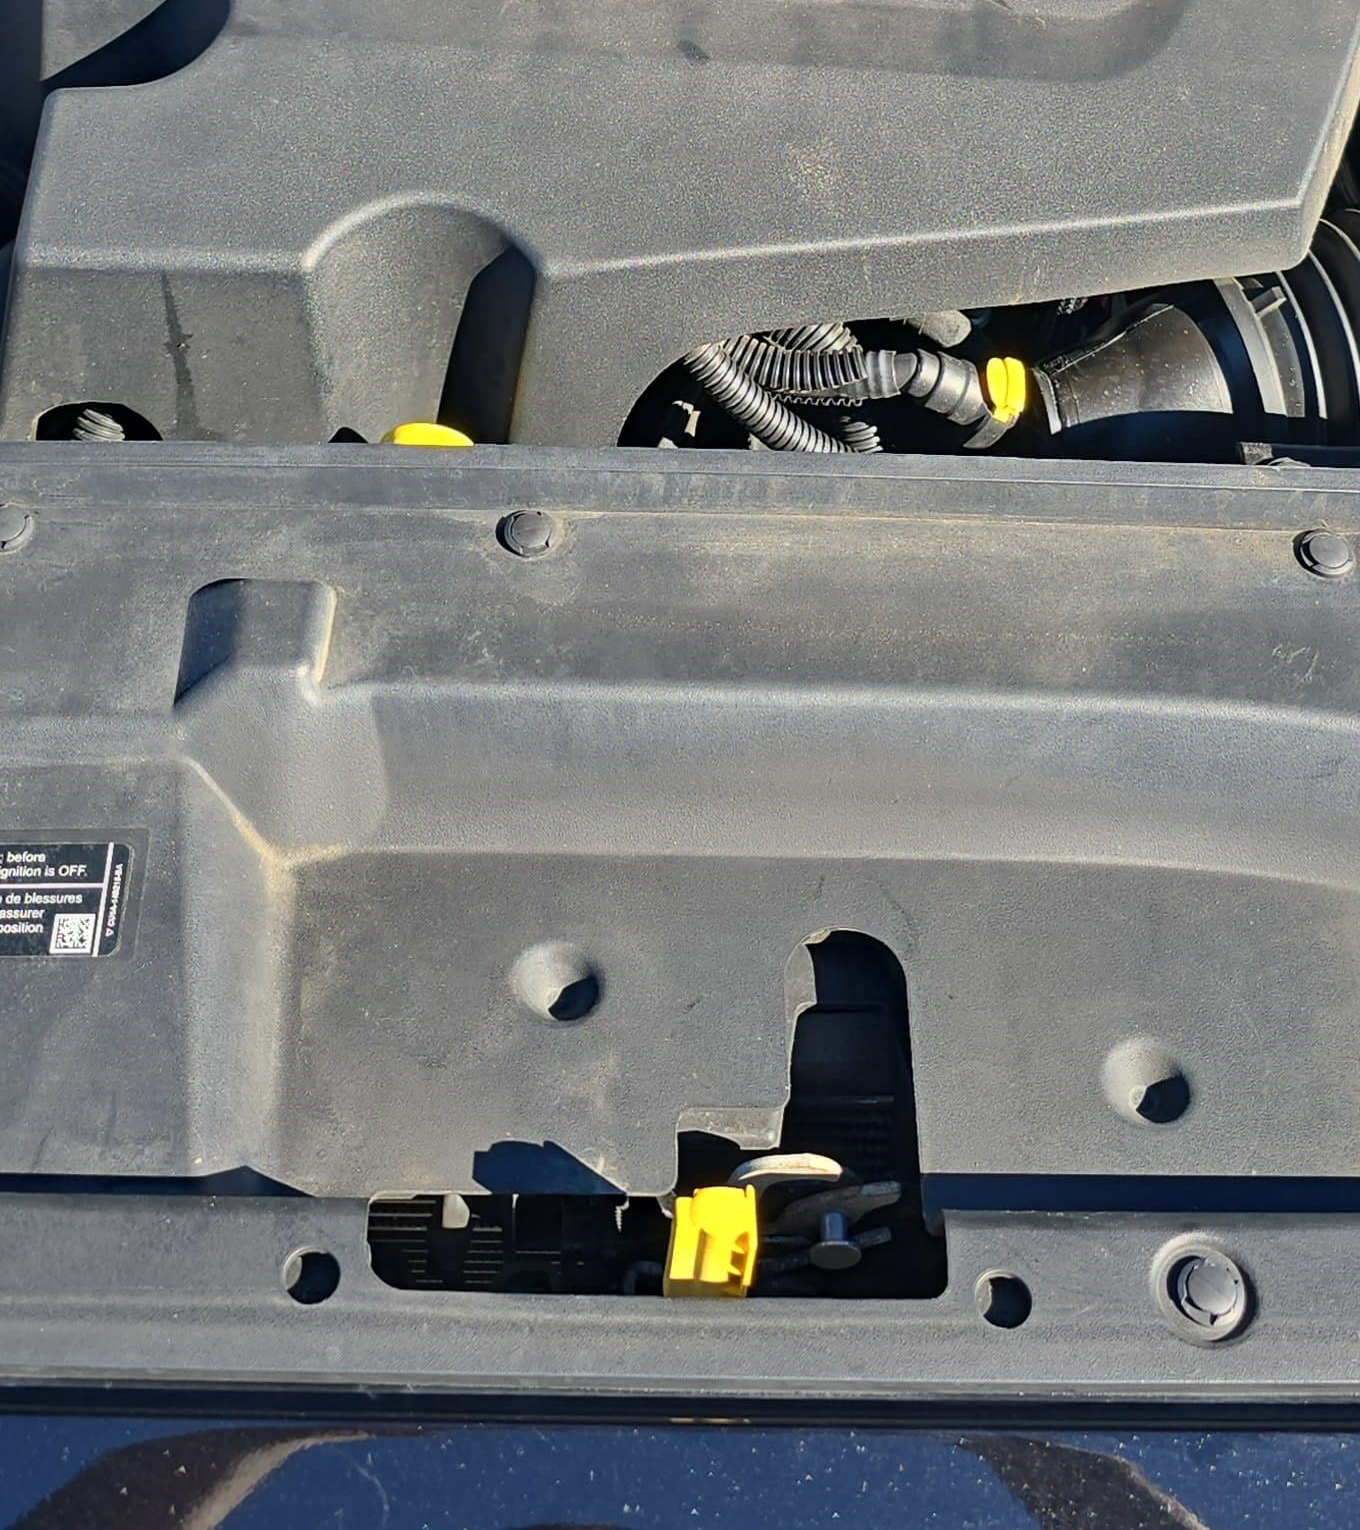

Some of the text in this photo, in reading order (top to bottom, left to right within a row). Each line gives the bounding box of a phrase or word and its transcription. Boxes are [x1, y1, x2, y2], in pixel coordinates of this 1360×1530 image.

[7, 851, 46, 862] before
[44, 865, 55, 876] is
[5, 893, 21, 903] de
[24, 892, 82, 903] blessures
